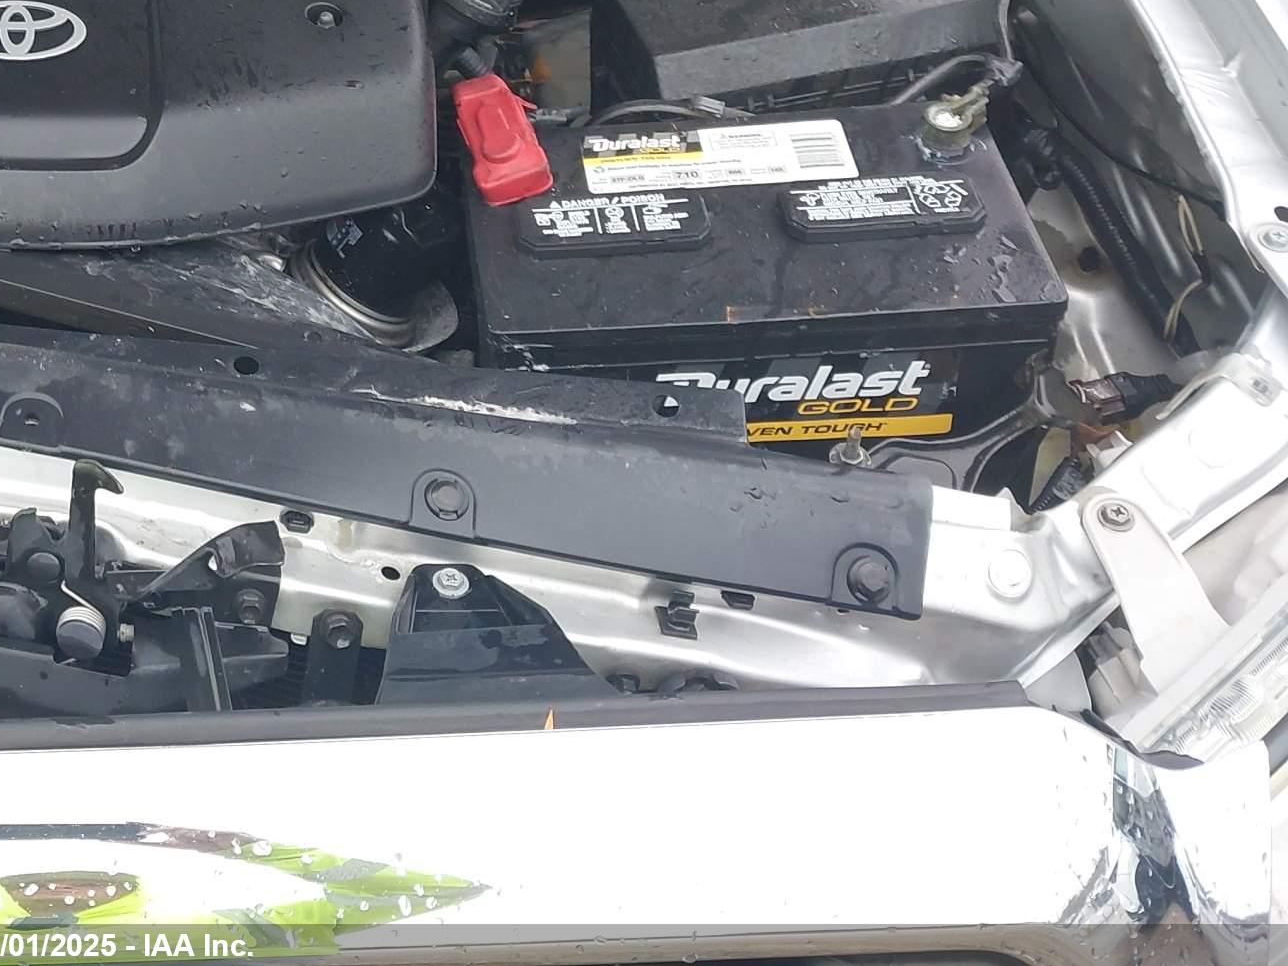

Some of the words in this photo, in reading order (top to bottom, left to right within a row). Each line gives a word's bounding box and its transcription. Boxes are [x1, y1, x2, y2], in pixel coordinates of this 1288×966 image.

[589, 135, 680, 152] Duralast
[675, 170, 699, 180] 710
[797, 397, 920, 416] GOLD
